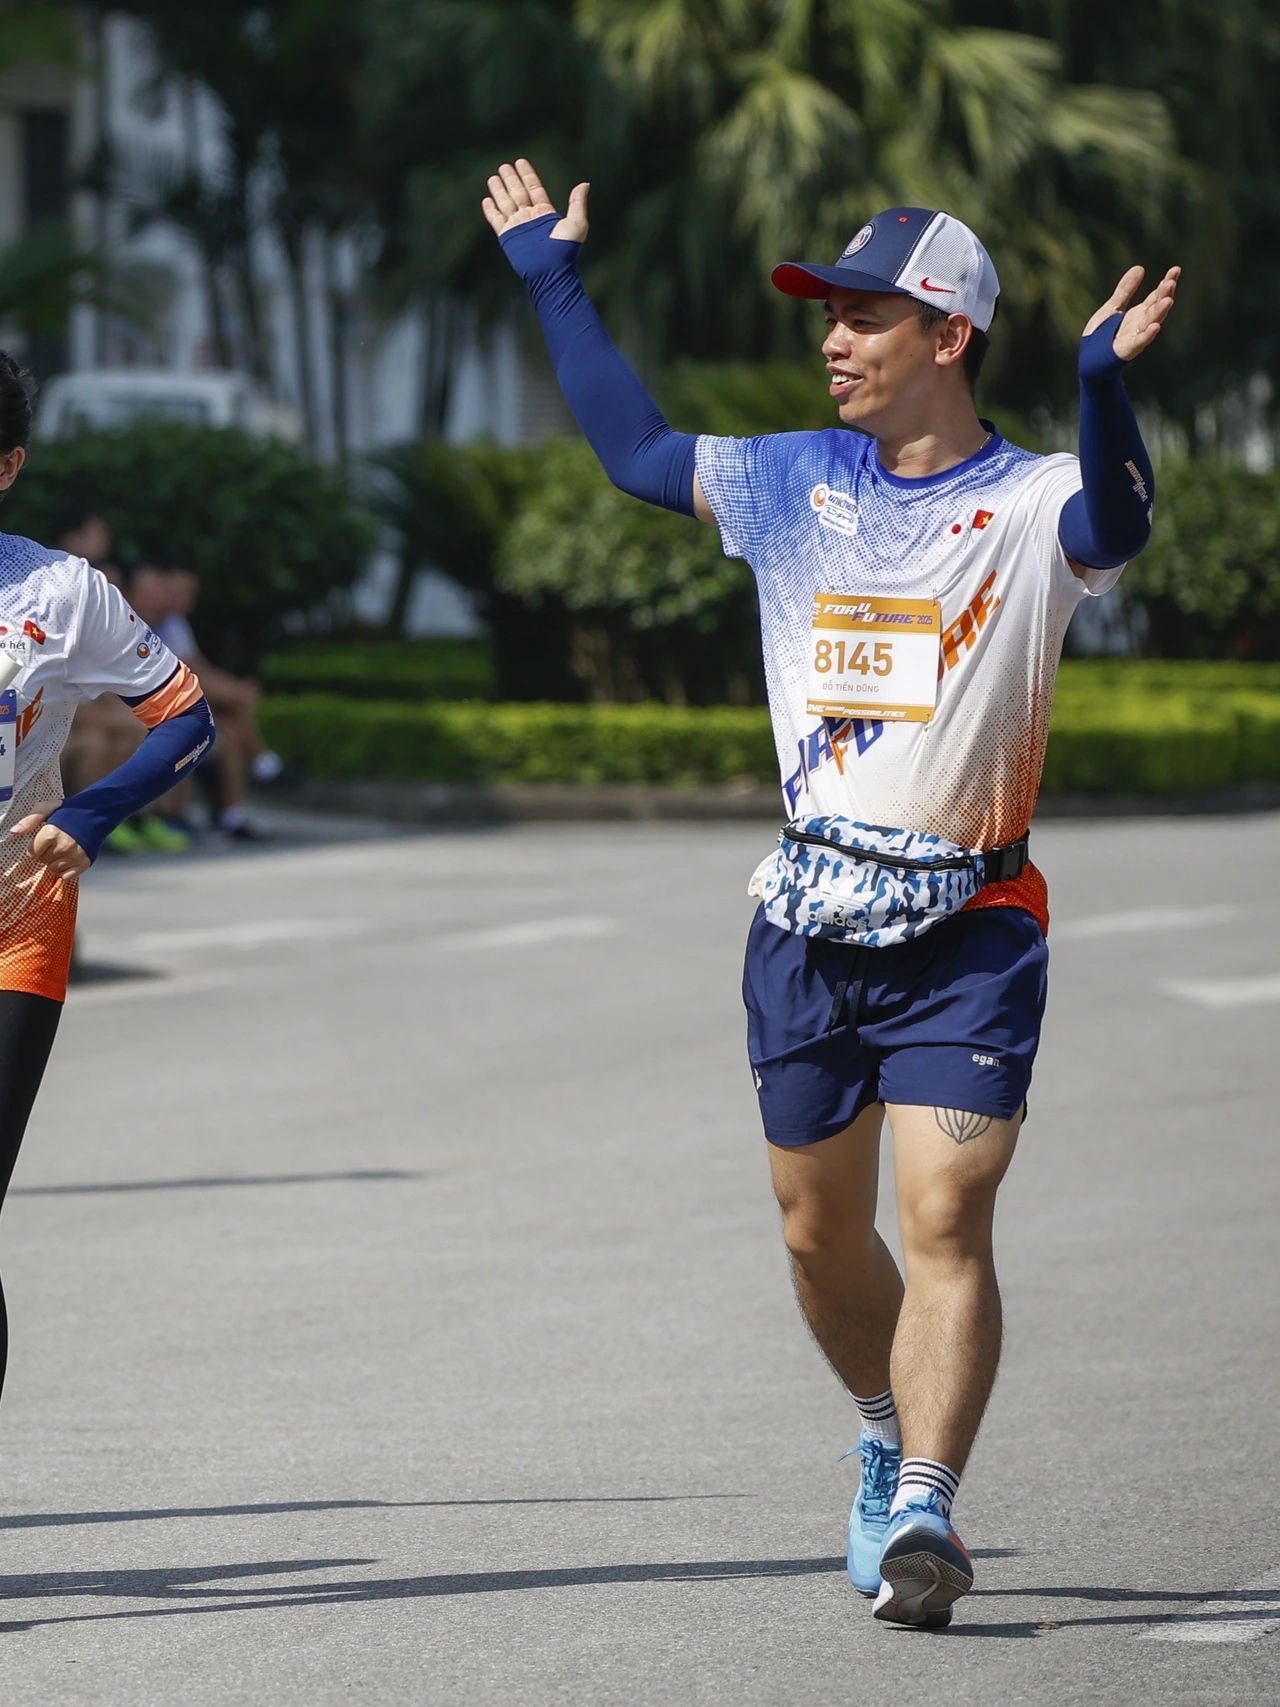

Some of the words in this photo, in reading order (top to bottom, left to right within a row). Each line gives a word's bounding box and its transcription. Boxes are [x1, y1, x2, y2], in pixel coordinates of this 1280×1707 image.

[851, 612, 916, 624] FUTURE
[917, 615, 933, 625] 2025
[814, 639, 893, 677] 8145
[835, 681, 854, 692] TIẾN
[856, 683, 879, 693] DŨNG
[842, 708, 907, 718] POSSIBILITIES
[808, 910, 867, 928] adidas
